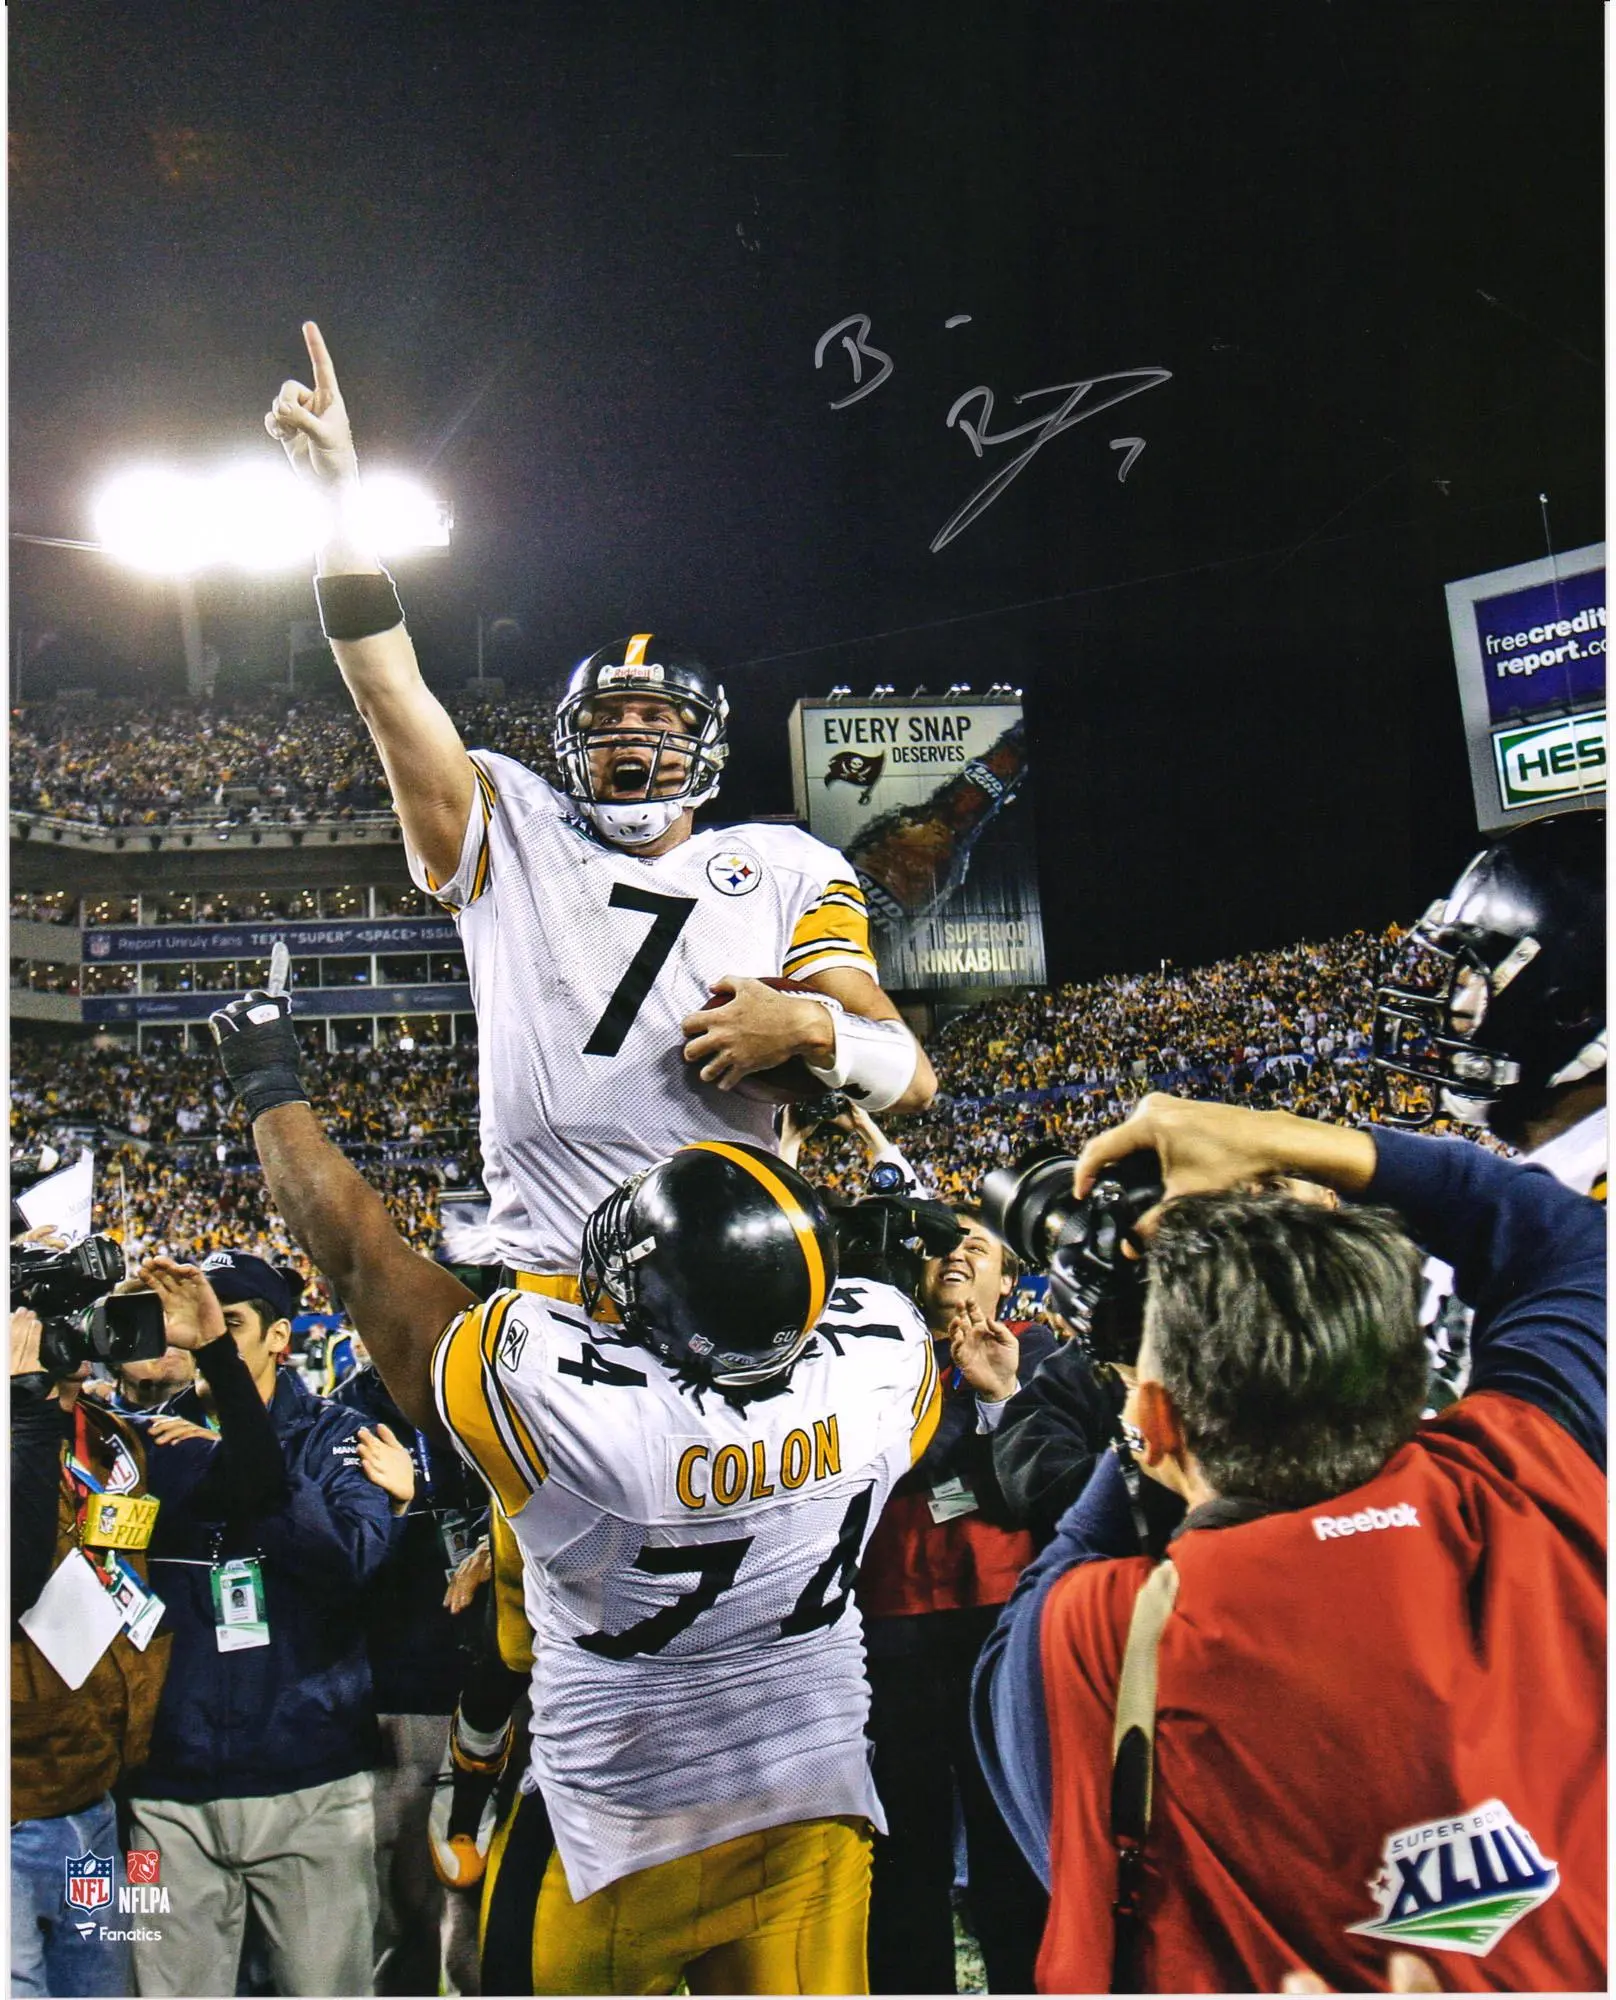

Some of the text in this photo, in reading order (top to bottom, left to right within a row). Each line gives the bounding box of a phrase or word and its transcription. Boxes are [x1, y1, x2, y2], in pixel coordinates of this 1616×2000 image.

[824, 716, 972, 745] EVERY SNAP
[893, 745, 966, 764] DESERVES
[118, 937, 163, 951] Report
[944, 921, 1030, 944] SUPERIOR
[582, 882, 699, 1058] 7
[676, 1414, 841, 1509] COLON
[126, 1503, 158, 1525] NF
[1312, 1502, 1421, 1541] Reebok
[1391, 1822, 1466, 1855] SUPER
